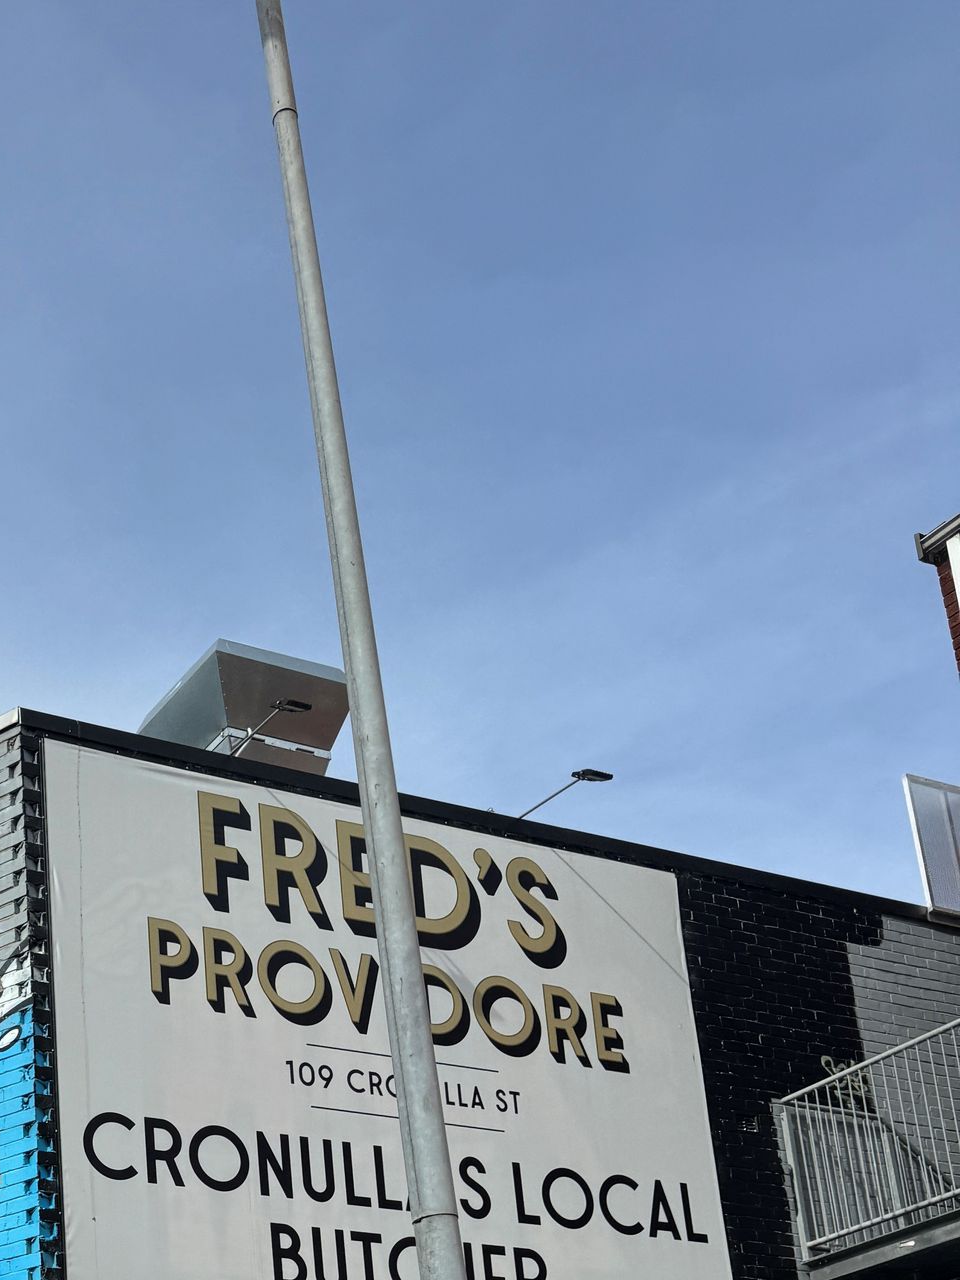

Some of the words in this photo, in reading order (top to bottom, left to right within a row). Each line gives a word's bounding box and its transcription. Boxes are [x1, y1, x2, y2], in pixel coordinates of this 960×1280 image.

[197, 790, 567, 969] FRED'S
[147, 916, 630, 1074] PROVDORE
[285, 1060, 334, 1089] 109
[346, 1069, 485, 1110] CRLLA
[495, 1089, 520, 1115] ST
[83, 1112, 491, 1220] CRONULLS
[512, 1161, 709, 1244] LOCAL
